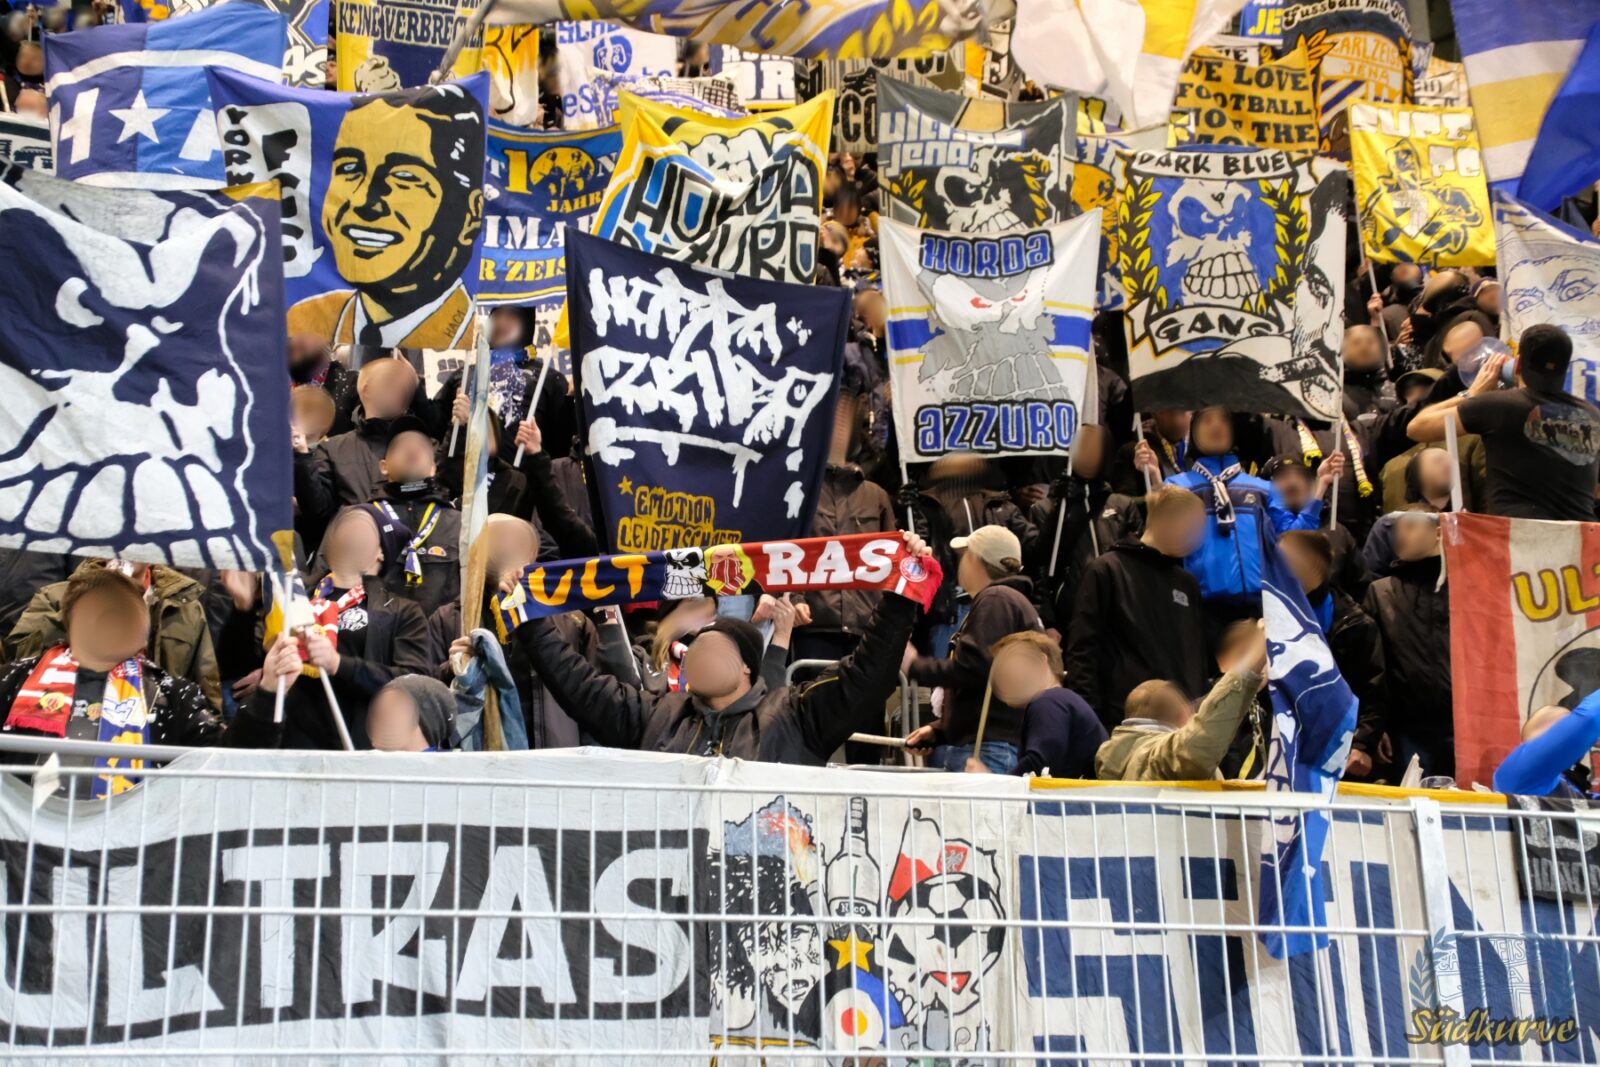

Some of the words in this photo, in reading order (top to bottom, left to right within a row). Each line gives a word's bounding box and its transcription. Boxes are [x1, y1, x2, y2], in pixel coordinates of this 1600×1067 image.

[1183, 58, 1222, 82] WE
[1233, 63, 1309, 91] LOVE
[1174, 82, 1312, 115] FOOTBALL
[1251, 121, 1316, 144] THE
[1137, 151, 1211, 176] DARK
[1222, 151, 1288, 177] BLUE
[546, 190, 606, 214] JAHR
[1155, 311, 1281, 342] GANG
[636, 487, 714, 526] EMOTION
[762, 539, 899, 586] RAS
[0, 841, 690, 1029] ULTRAS
